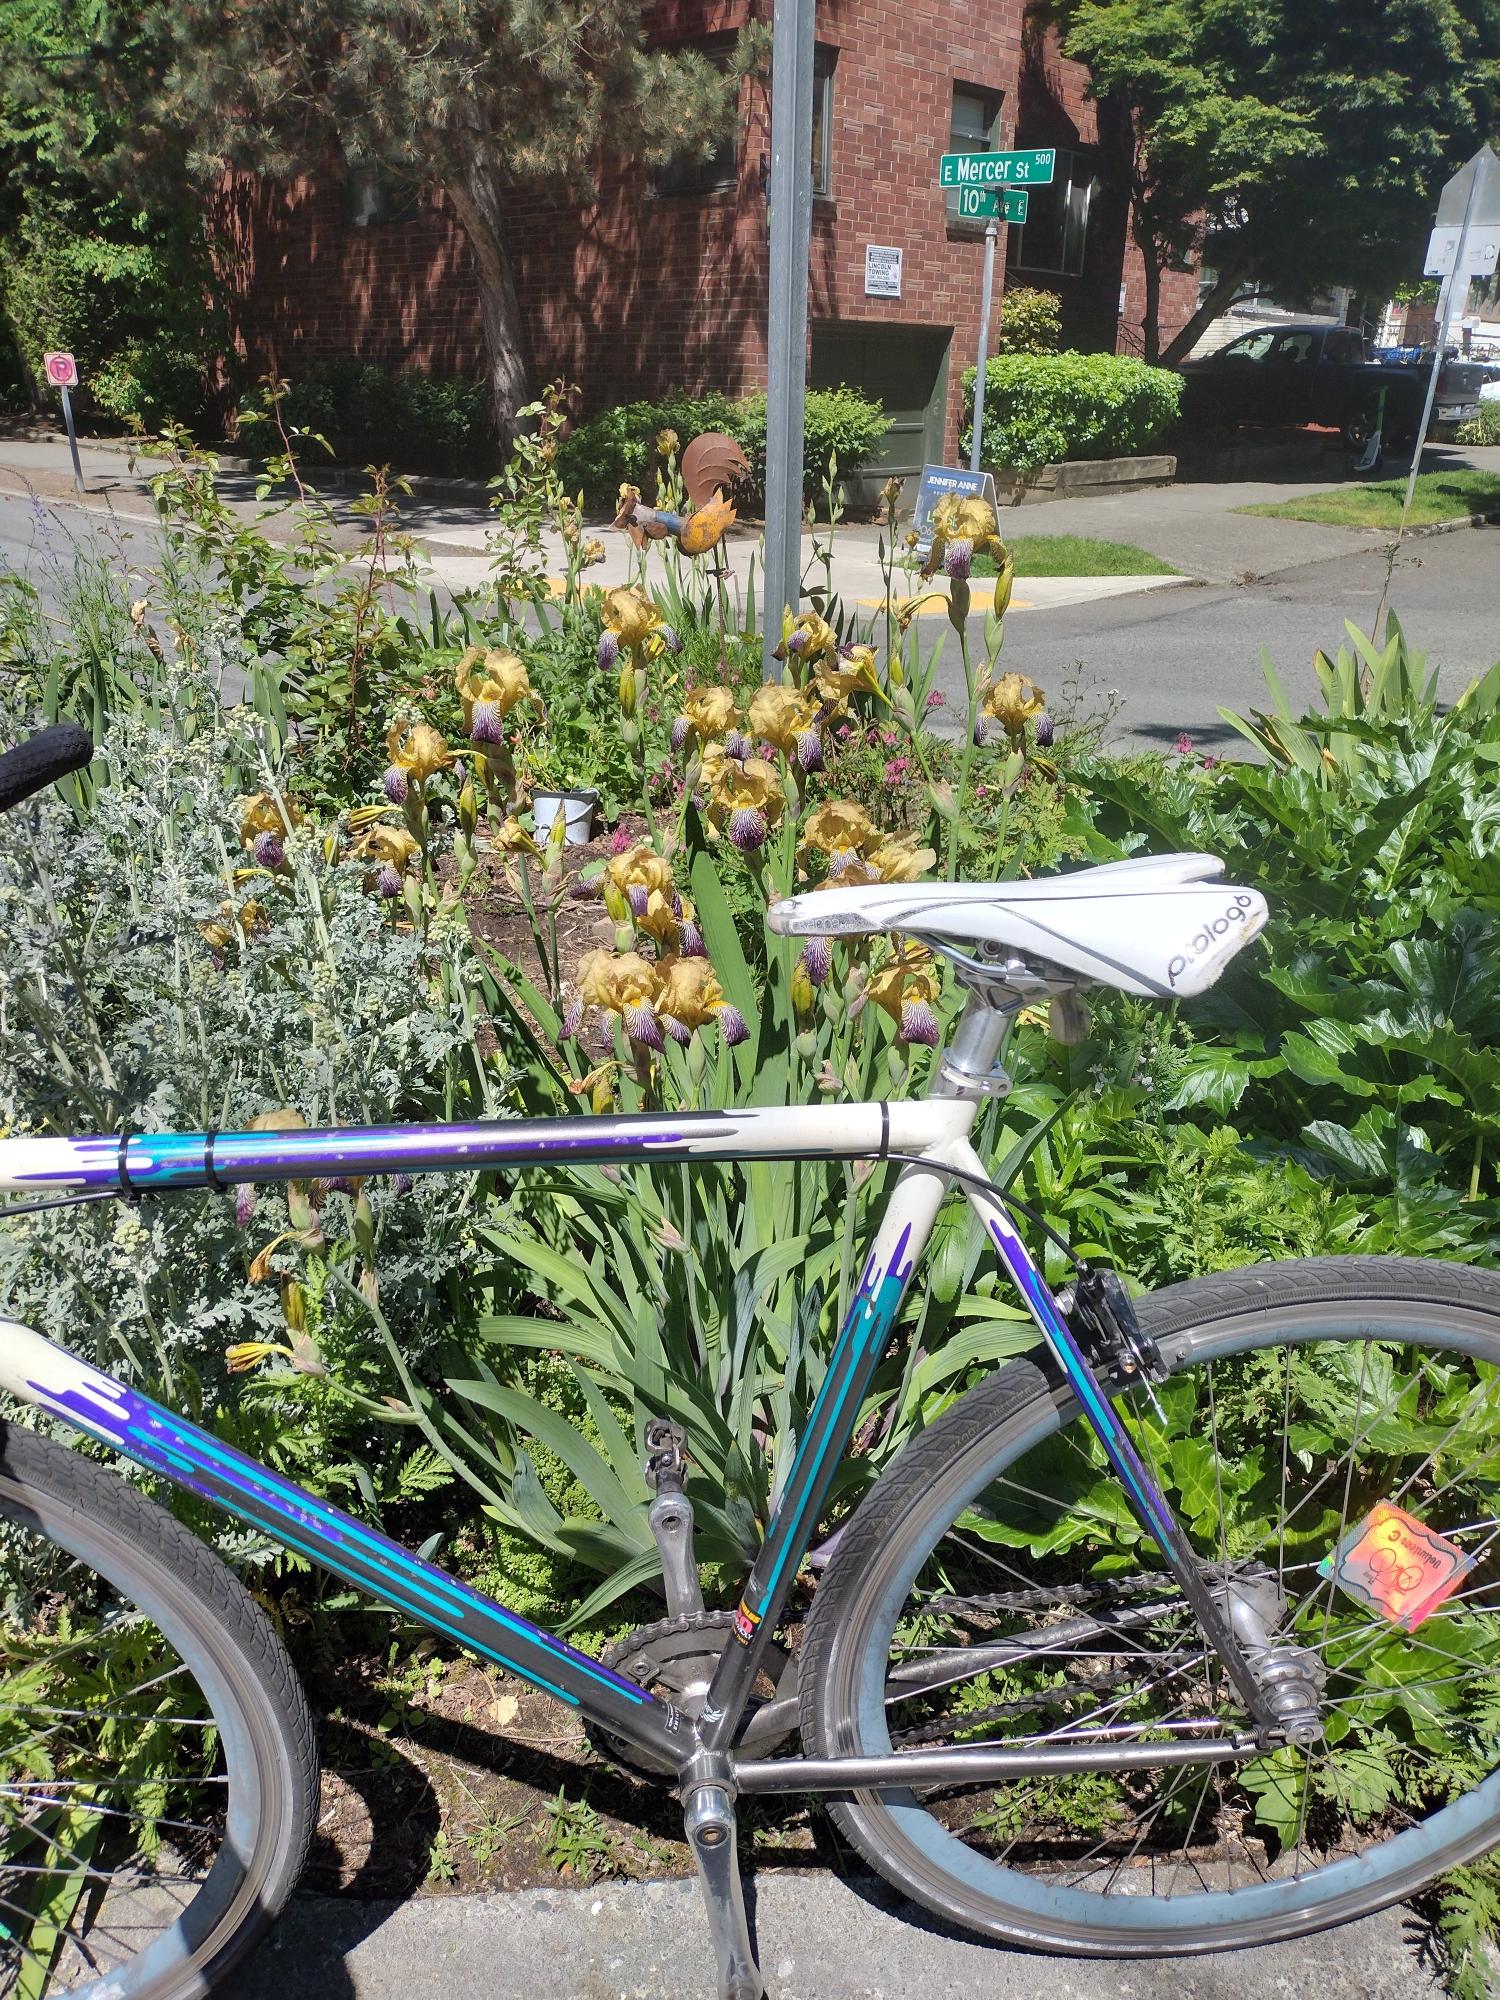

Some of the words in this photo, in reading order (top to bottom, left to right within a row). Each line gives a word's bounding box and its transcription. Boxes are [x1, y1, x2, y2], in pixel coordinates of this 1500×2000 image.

[944, 165, 953, 182] E
[957, 157, 1012, 181] Mercer
[1015, 161, 1030, 179] St
[1035, 153, 1051, 165] 500
[963, 188, 986, 214] 10th
[868, 262, 892, 271] LINCOLN
[868, 268, 890, 277] TOWING
[927, 476, 957, 488] JENNIFER
[957, 480, 979, 491] ANNE
